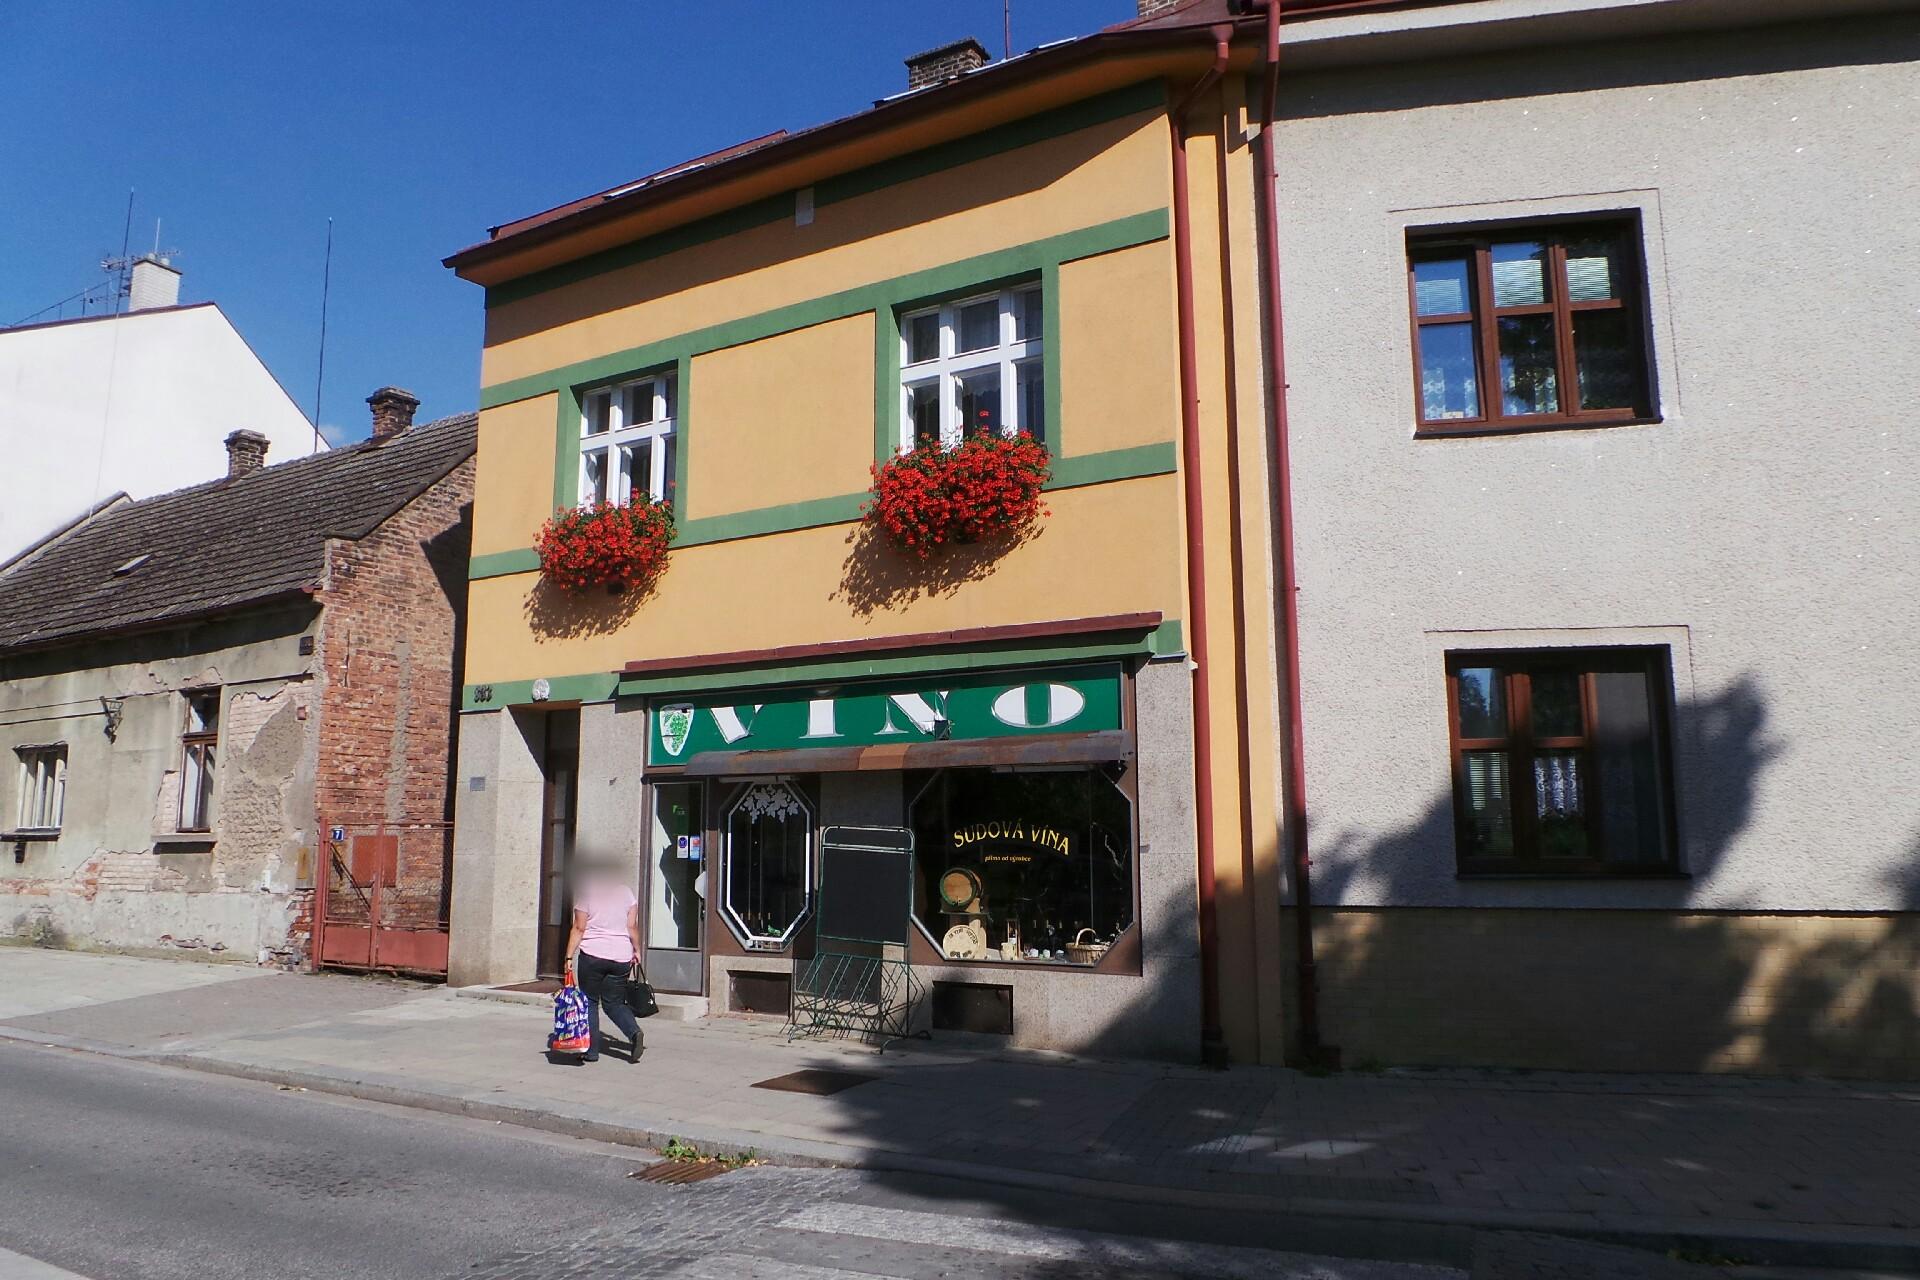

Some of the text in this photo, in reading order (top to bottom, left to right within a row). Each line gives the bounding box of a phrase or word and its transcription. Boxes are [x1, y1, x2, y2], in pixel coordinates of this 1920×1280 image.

[708, 682, 1086, 745] VINO
[335, 830, 341, 839] 7
[953, 818, 1069, 856] SUDOVÁ VÍNA
